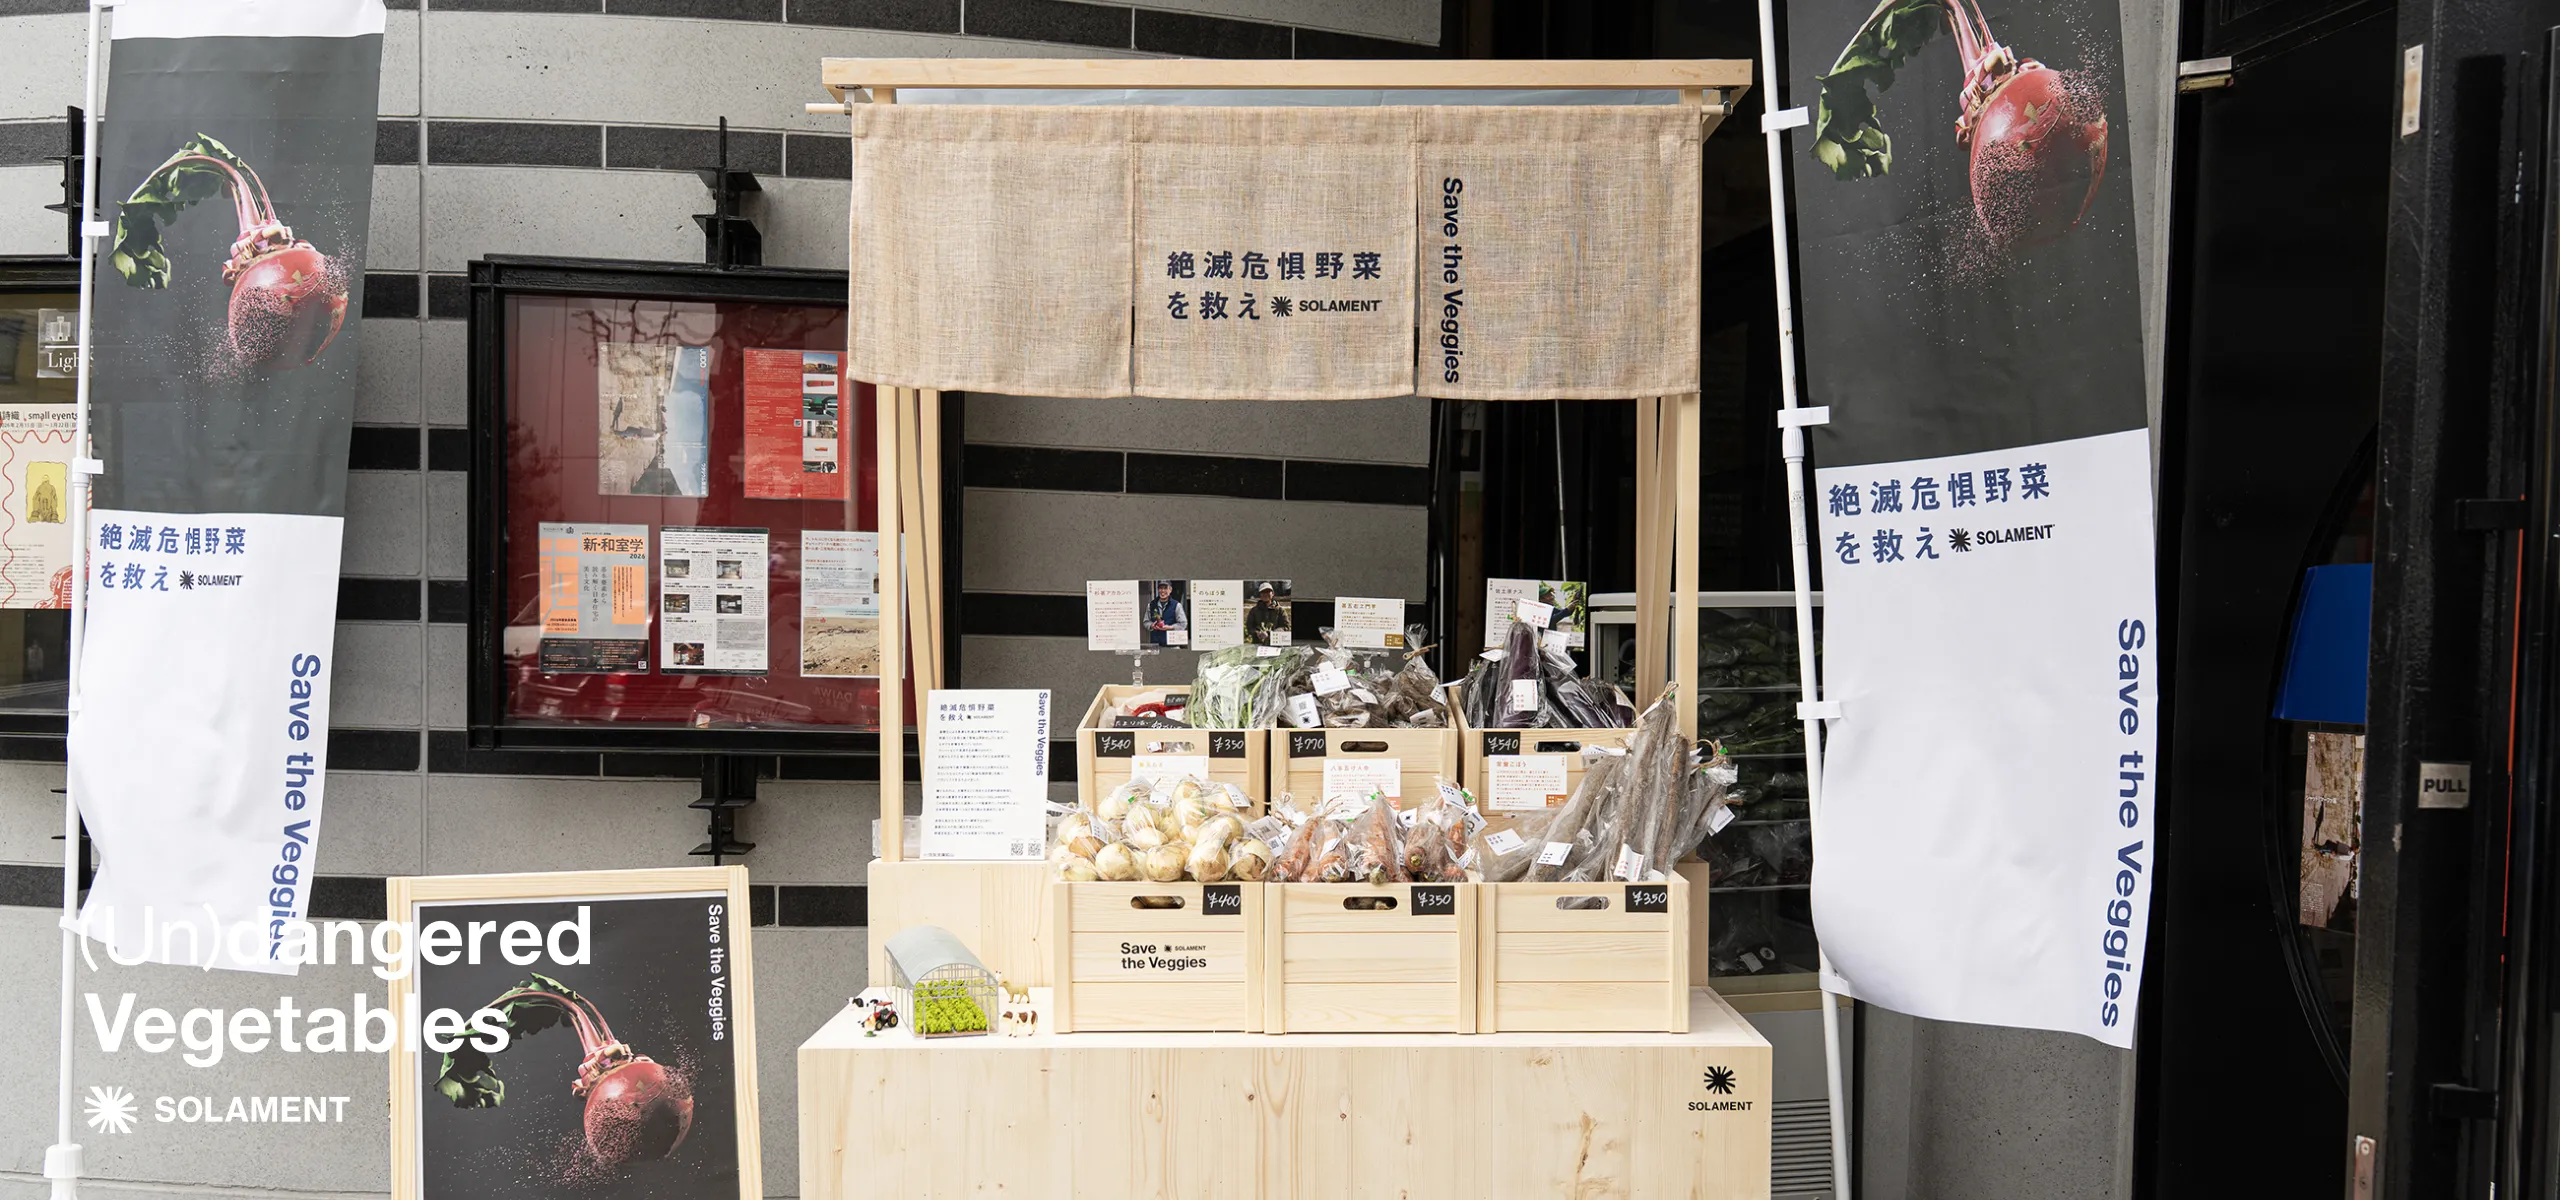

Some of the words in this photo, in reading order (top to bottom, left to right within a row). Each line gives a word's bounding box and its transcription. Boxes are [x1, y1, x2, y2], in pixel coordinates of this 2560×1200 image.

[1443, 177, 1463, 238] Save
[1167, 251, 1381, 280] 絶滅危惧野菜
[1443, 244, 1463, 284] the
[1167, 291, 1260, 320] を救え
[1299, 300, 1381, 312] SOLAMENT
[1441, 289, 1463, 383] Veggies
[48, 352, 80, 373] Ligh
[28, 411, 50, 420] small
[1828, 462, 2051, 517] 絶滅危惧野菜
[100, 523, 246, 555] 絶滅危惧野菜
[1834, 525, 1941, 565] を救え
[1976, 524, 2054, 546] SOLAMENT
[100, 561, 169, 592] を救え
[197, 573, 244, 587] SOLAMENT
[2117, 619, 2146, 735] Save
[288, 652, 321, 741] Save
[1038, 692, 1048, 716] Save
[1037, 718, 1047, 735] the
[1034, 737, 1047, 776] Veggies
[1101, 736, 1131, 753] ¥540
[1213, 736, 1244, 753] ¥350
[1294, 736, 1325, 753] ¥770
[1488, 736, 1519, 752] ¥540
[283, 752, 315, 811] the
[2118, 751, 2145, 828] the
[2424, 778, 2467, 792] PULL
[1207, 892, 1241, 908] ¥400
[1417, 892, 1452, 907] ¥350
[1632, 891, 1667, 906] ¥350
[708, 903, 724, 938] Save
[2101, 840, 2144, 1028] Veggies
[709, 943, 725, 970] the
[1121, 943, 1157, 955] Save
[1121, 957, 1145, 969] the
[1148, 957, 1207, 971] Veggies
[708, 973, 726, 1041] Veggies
[1688, 1102, 1752, 1111] SOLAMENT
